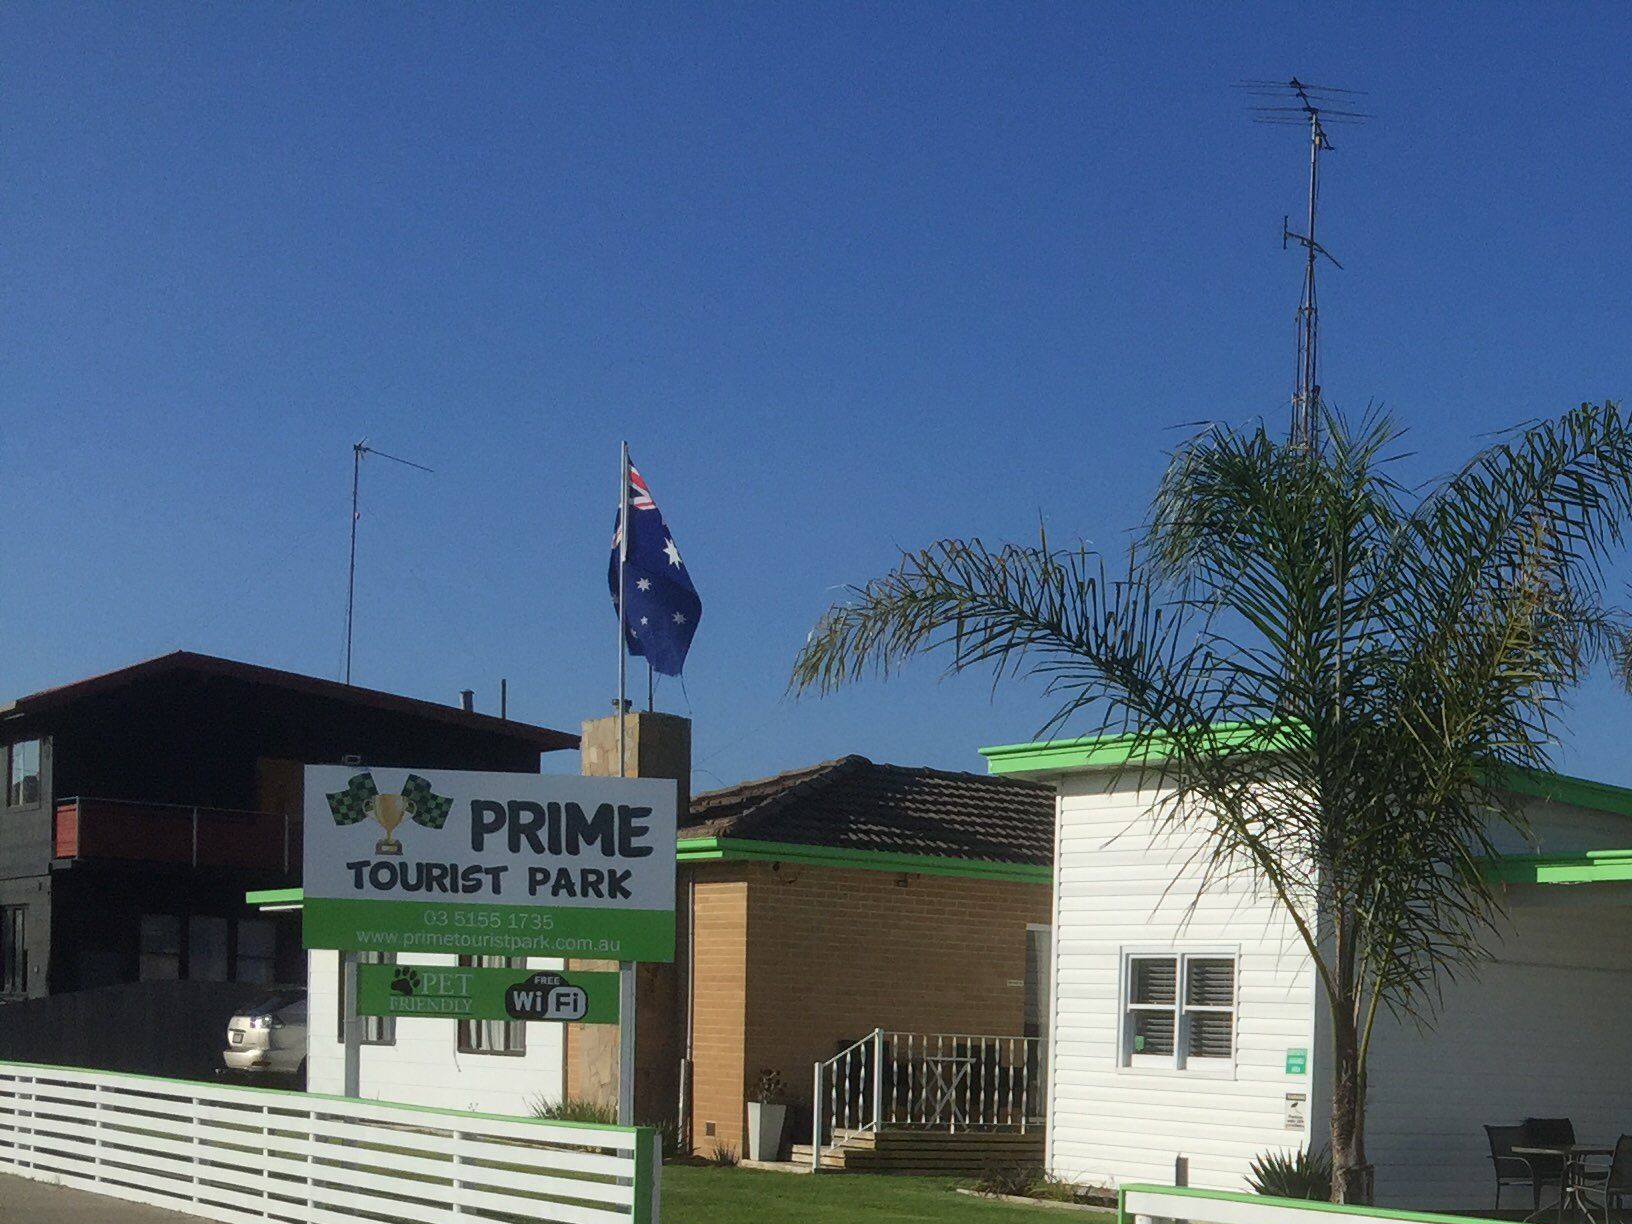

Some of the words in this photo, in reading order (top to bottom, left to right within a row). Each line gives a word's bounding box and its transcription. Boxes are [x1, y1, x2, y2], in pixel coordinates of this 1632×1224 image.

[470, 799, 654, 858] PRIME
[346, 860, 508, 895] TOURIST
[528, 866, 632, 900] PARK
[424, 910, 449, 926] 03
[454, 912, 501, 928] 5155
[508, 913, 554, 930] 1735
[356, 929, 620, 951] www.primetouristpark.com.au
[421, 972, 474, 995] PET
[534, 975, 560, 985] FREE
[390, 996, 473, 1013] FRIENDLY
